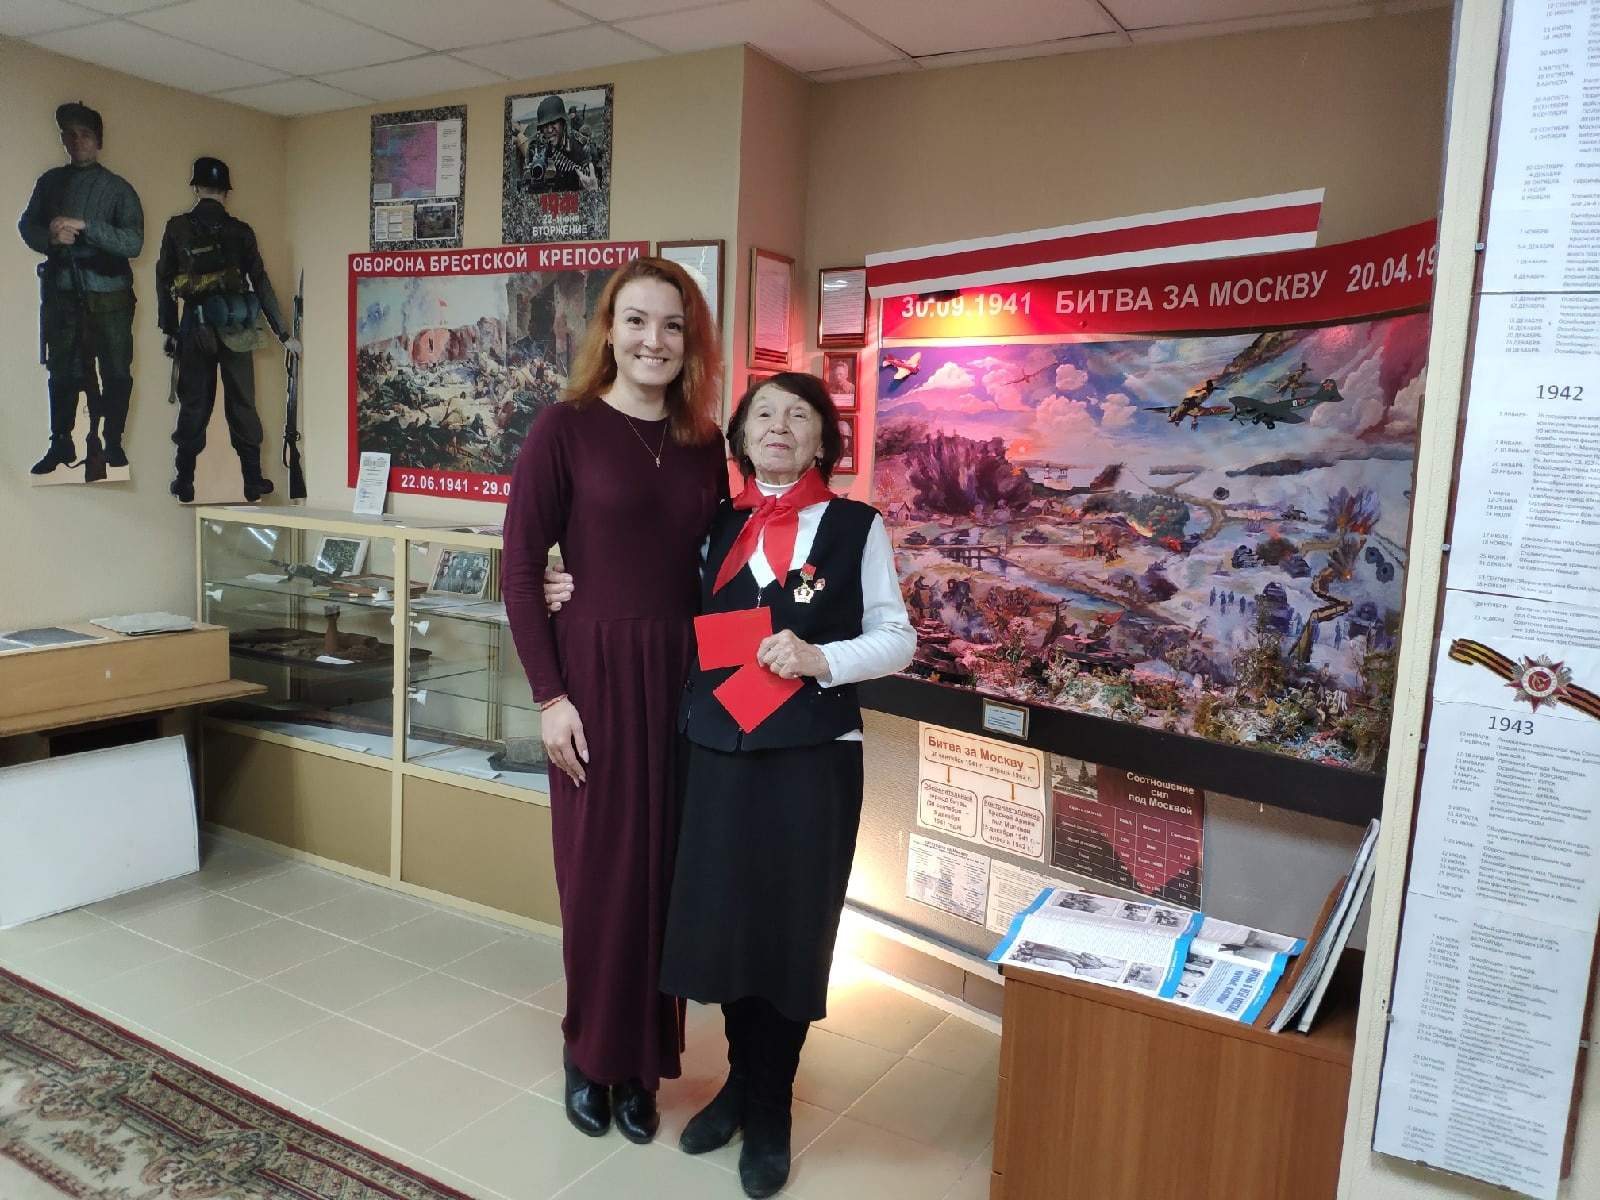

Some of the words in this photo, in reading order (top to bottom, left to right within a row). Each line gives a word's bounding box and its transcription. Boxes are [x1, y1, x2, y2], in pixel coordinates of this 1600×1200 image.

[532, 224, 588, 237] ВТОРЖЕНИЕ
[353, 255, 426, 273] ОБОРОНА
[430, 248, 529, 273] БРЕСТСКОЙ
[539, 246, 640, 268] КРЕПОСТИ
[901, 291, 1031, 318] 30.09.1941
[1055, 287, 1153, 314] БИТВА
[1162, 283, 1200, 310] ЗА
[1209, 269, 1328, 307] МОСКВУ
[1346, 244, 1437, 293] 20.04.19
[1536, 384, 1584, 401] 1942
[401, 474, 469, 493] 22.06.1941
[1488, 715, 1535, 736] 1943
[928, 736, 962, 754] Битва
[964, 748, 977, 758] за
[980, 748, 1024, 771] Москву
[1126, 771, 1195, 796] Соотношение
[1151, 789, 1169, 799] сил
[1128, 793, 1147, 806] под
[1149, 796, 1193, 816] Москвой
